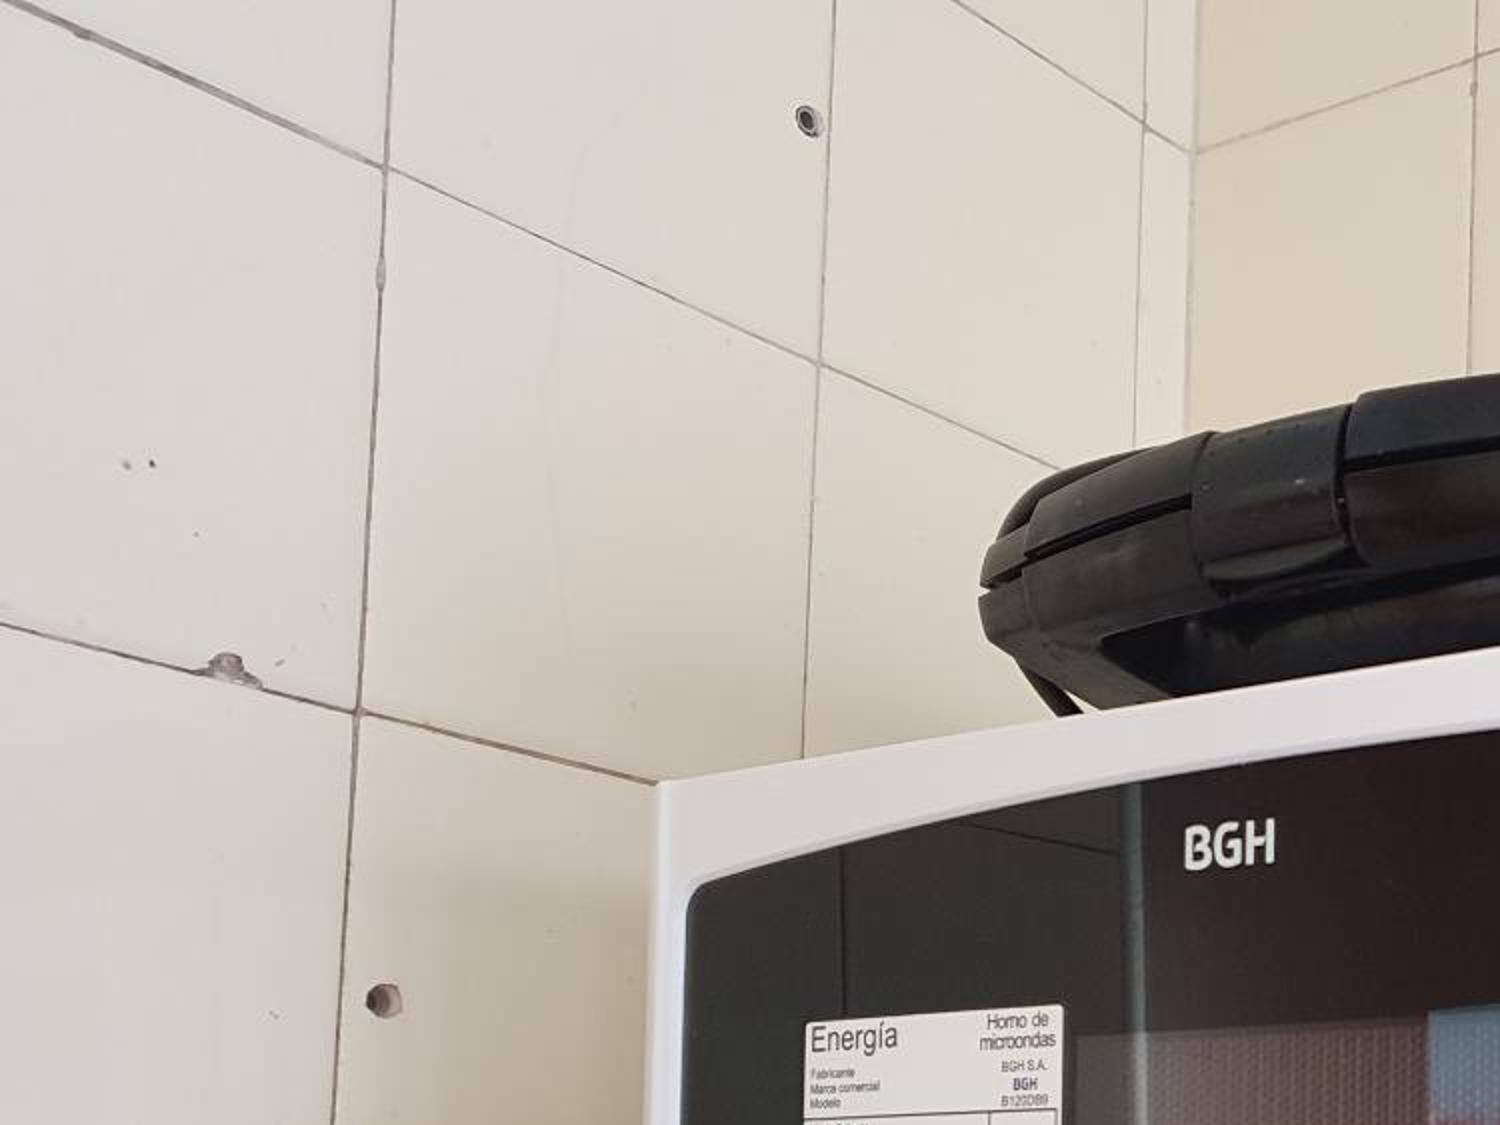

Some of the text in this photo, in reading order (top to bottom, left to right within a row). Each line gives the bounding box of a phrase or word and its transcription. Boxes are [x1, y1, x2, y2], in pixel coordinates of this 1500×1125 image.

[1184, 818, 1275, 871] BGH
[1031, 1011, 1049, 1027] de
[811, 1021, 898, 1056] Energía
[979, 1031, 1057, 1051] microondas
[1001, 1059, 1048, 1072] BGH S.A.
[810, 1080, 881, 1095] Marca comercial
[1013, 1077, 1038, 1091] BGH
[810, 1098, 841, 1109] Modelo
